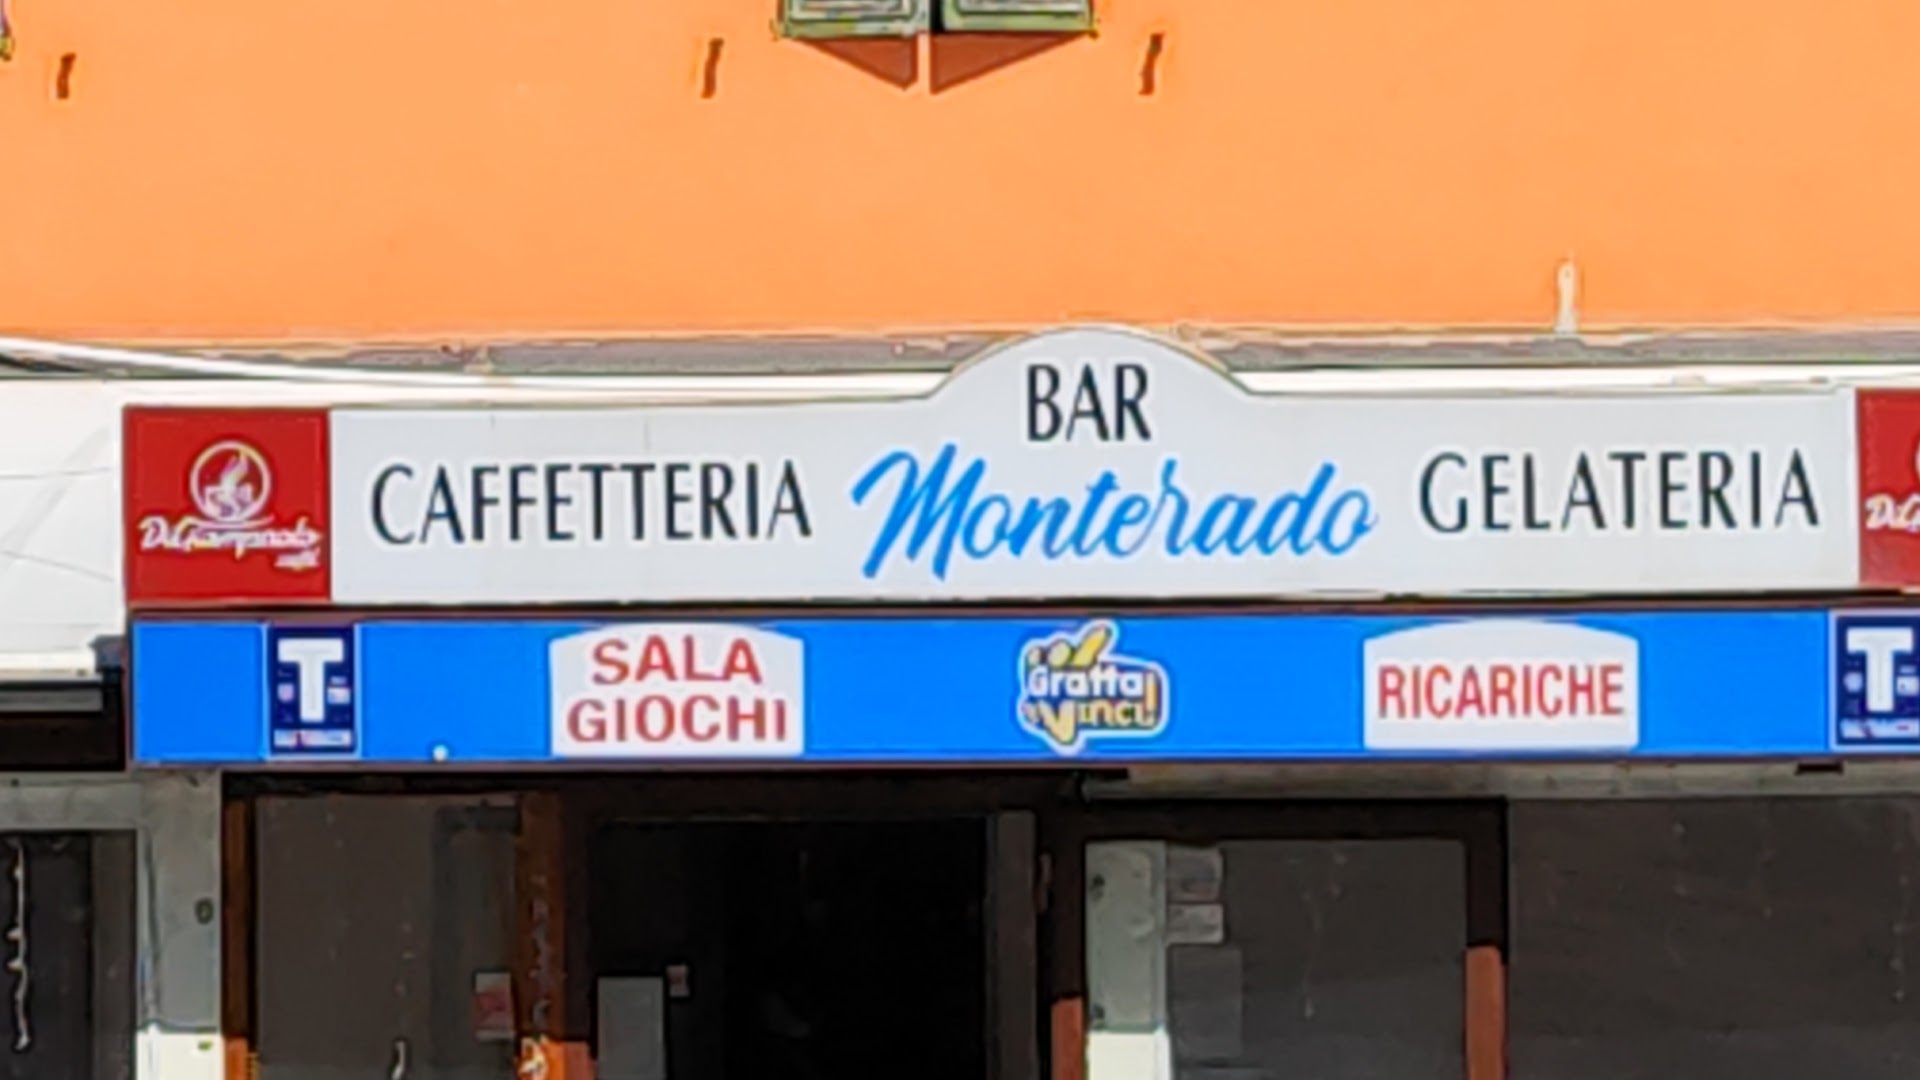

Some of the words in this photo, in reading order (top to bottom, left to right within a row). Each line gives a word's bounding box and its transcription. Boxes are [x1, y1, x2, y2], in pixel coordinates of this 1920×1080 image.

[1026, 363, 1152, 442] BAR
[371, 459, 813, 545] CAFFETTERIA
[851, 443, 1378, 581] Monterado
[1418, 448, 1820, 533] GELATERIA
[277, 637, 345, 723] T
[592, 634, 762, 685] SALA
[1028, 664, 1145, 697] Gratta
[1377, 664, 1625, 719] RICARICHE
[1846, 627, 1914, 712] T
[567, 695, 787, 743] GIOCHI
